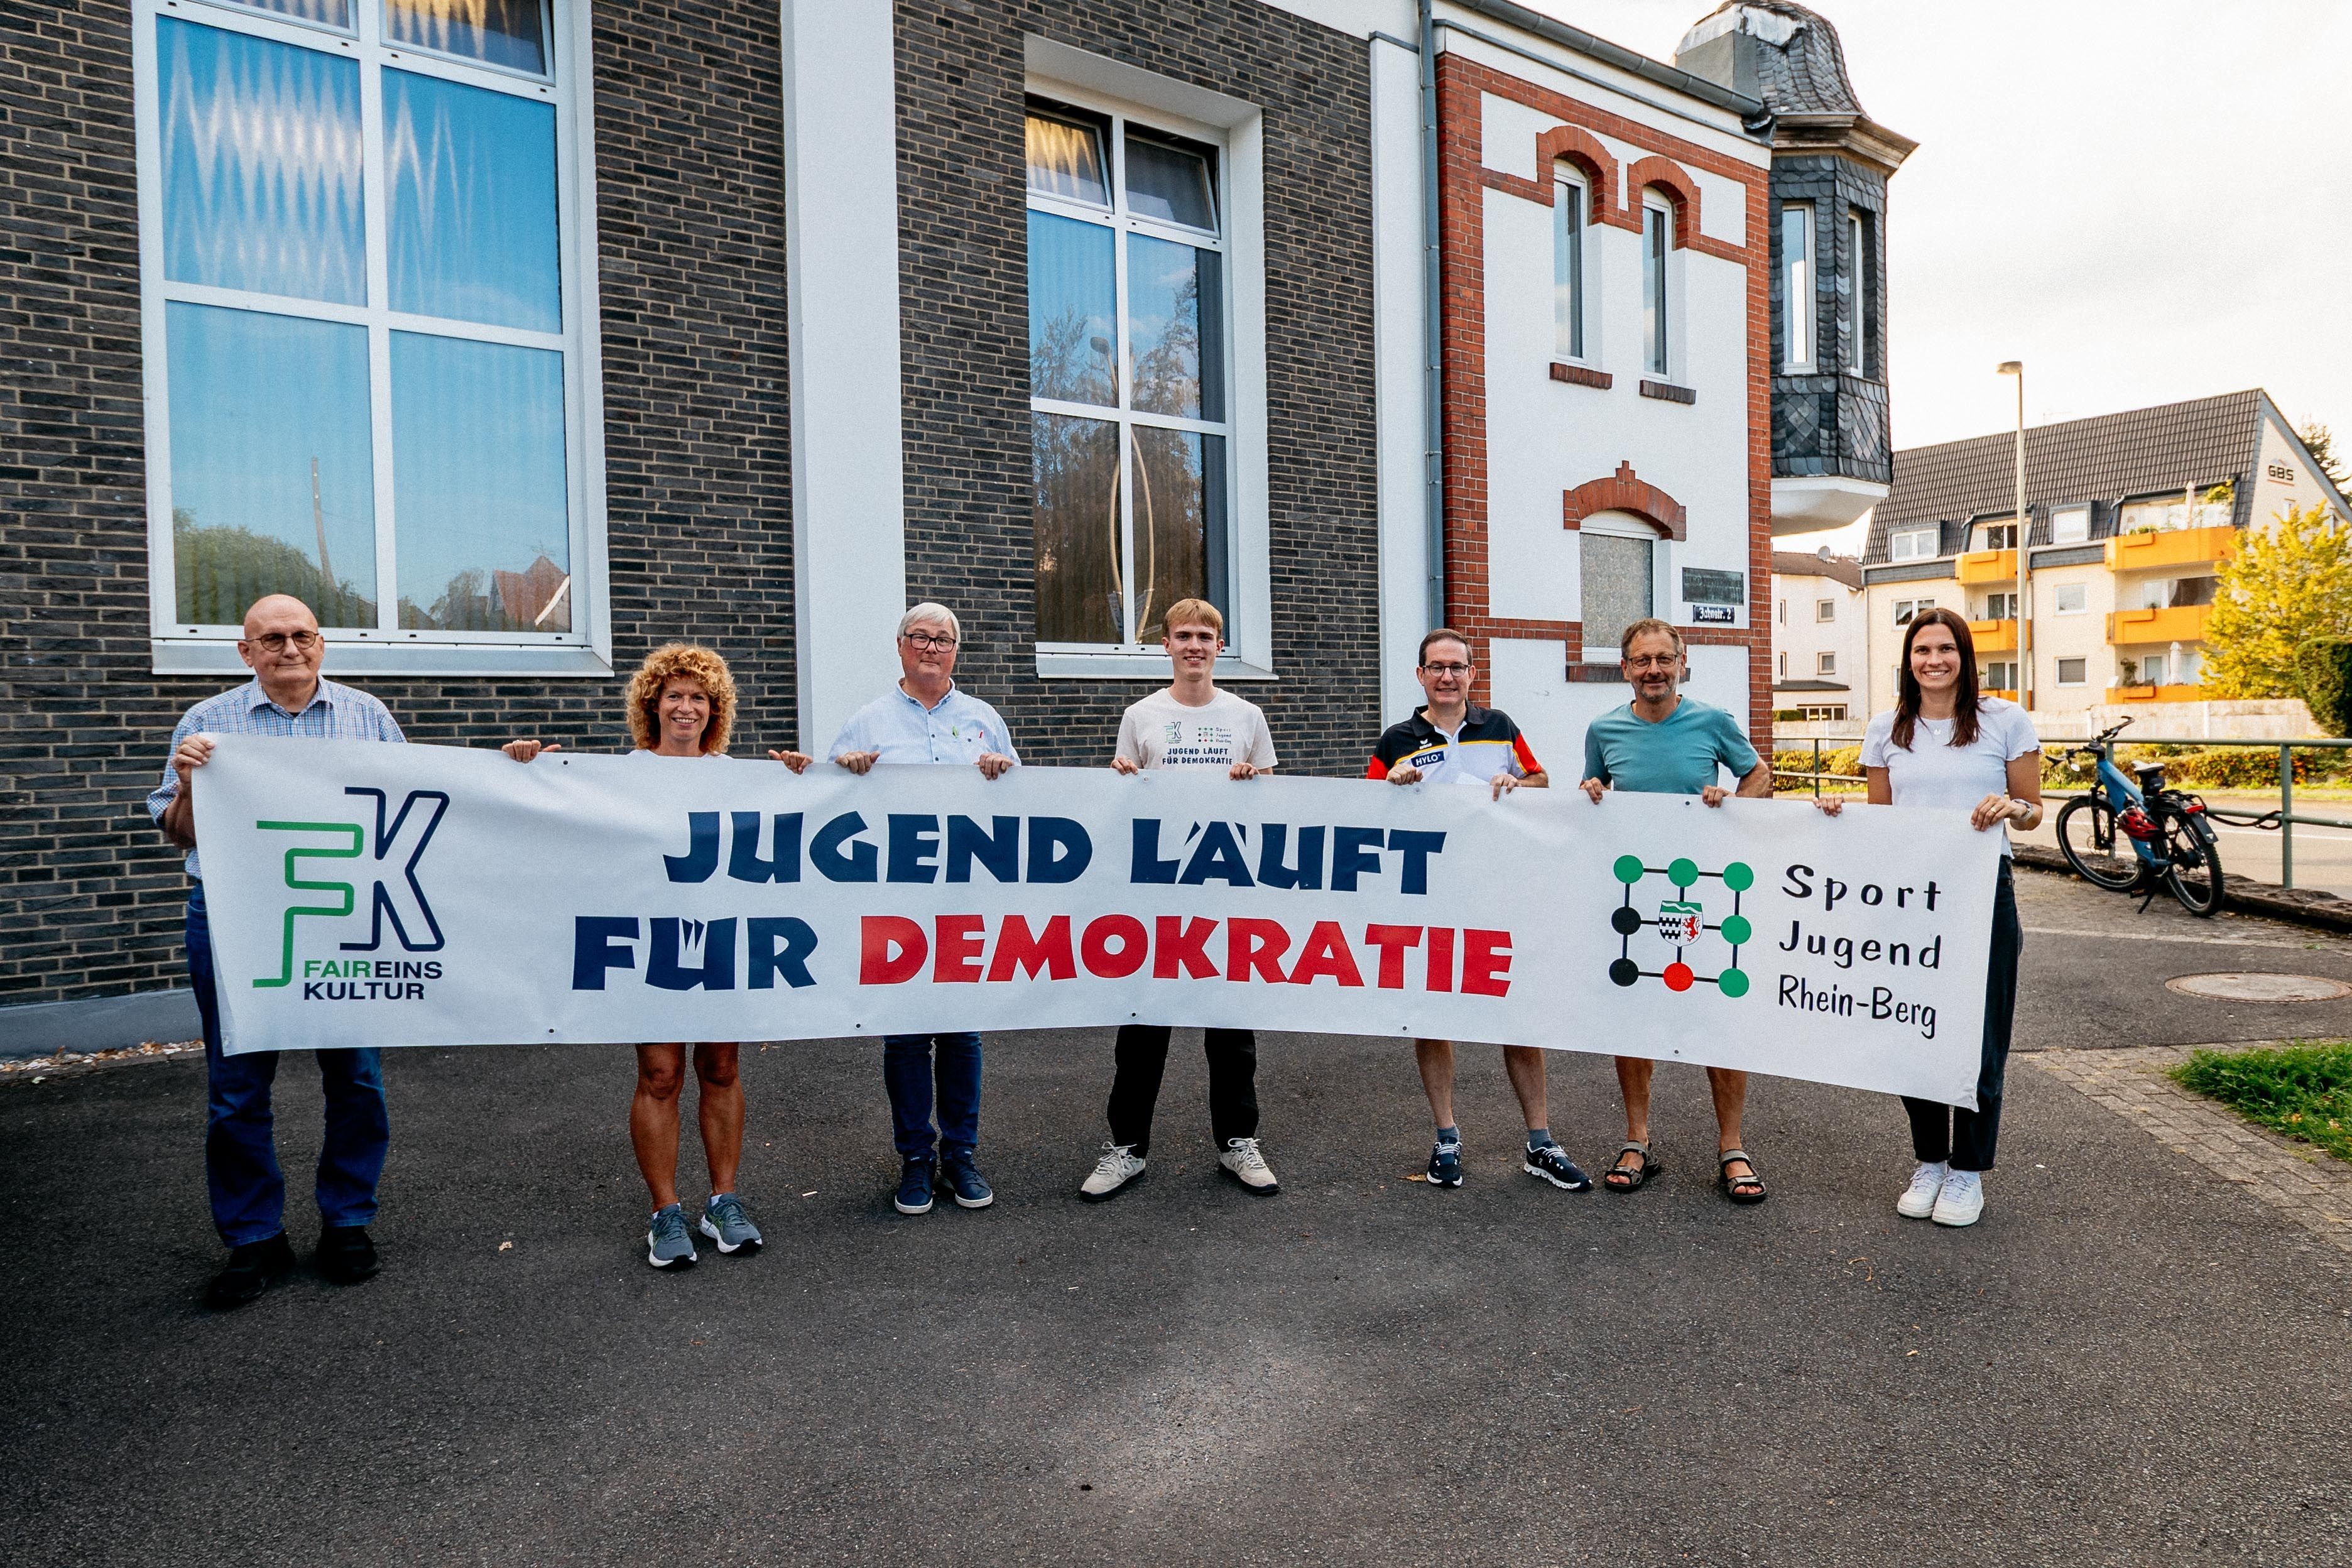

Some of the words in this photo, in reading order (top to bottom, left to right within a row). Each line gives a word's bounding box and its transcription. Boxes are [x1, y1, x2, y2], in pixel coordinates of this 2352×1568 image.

[2268, 465, 2294, 481] GBS
[1727, 608, 1731, 620] 2
[1162, 756, 1179, 765] FÜR
[1181, 756, 1233, 765] DEMOKRATIE
[1203, 746, 1229, 755] LÄUFT
[1415, 754, 1439, 766] HYLO
[662, 810, 1093, 884] JUGEND
[1130, 817, 1447, 895] LÄUFT
[1781, 864, 1942, 912] Sport
[1778, 920, 1942, 970] Jugend
[572, 915, 819, 991] FÜR
[859, 913, 1513, 998] DEMOKRATIE
[303, 959, 443, 979] FAIREINS
[303, 981, 425, 1001] KULTUR
[1778, 974, 1937, 1040] Rhein-Berg
